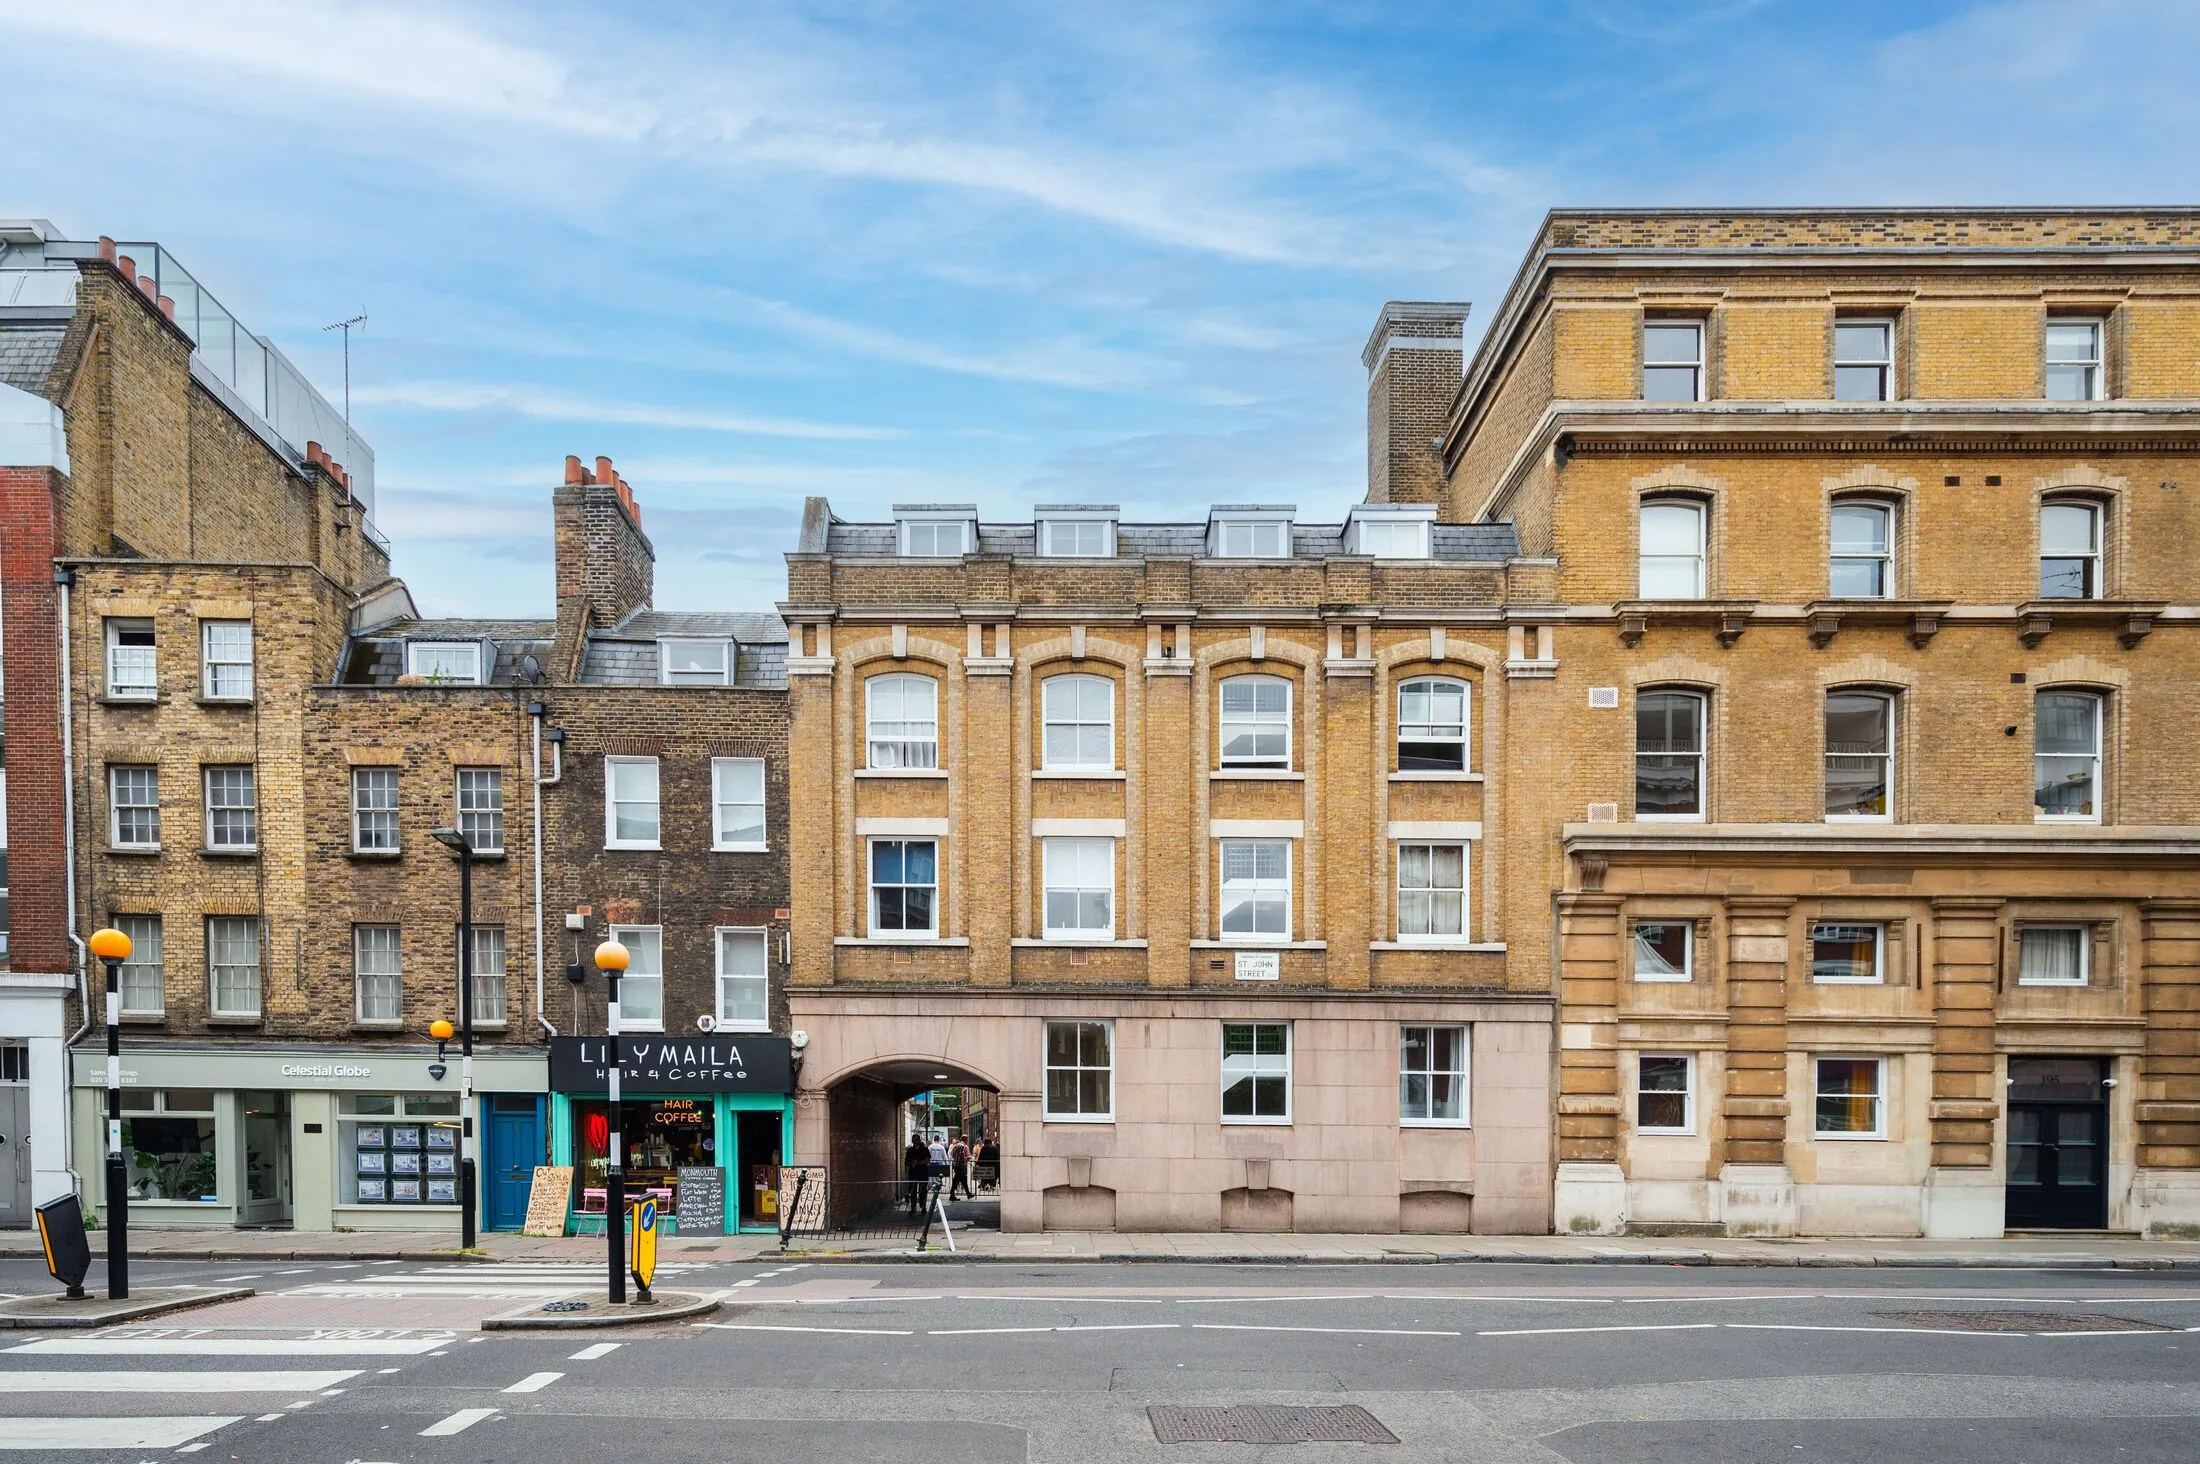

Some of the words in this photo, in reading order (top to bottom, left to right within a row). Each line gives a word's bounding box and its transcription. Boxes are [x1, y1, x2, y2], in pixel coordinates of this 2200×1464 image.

[1238, 960, 1250, 968] ST.
[1252, 960, 1273, 968] JOHN
[659, 1045, 743, 1066] MAILA
[281, 1065, 332, 1077] Celestial
[334, 1065, 371, 1077] Globe
[596, 1069, 639, 1079] HIR
[648, 1069, 660, 1080] &
[2041, 1074, 2060, 1083] 195
[664, 1100, 693, 1109] HAIR
[655, 1112, 702, 1123] COFFEE
[680, 1168, 718, 1177] MONMOUTH
[781, 1169, 824, 1179] Welome
[781, 1191, 821, 1203] Cofee
[782, 1203, 821, 1217] DNKS
